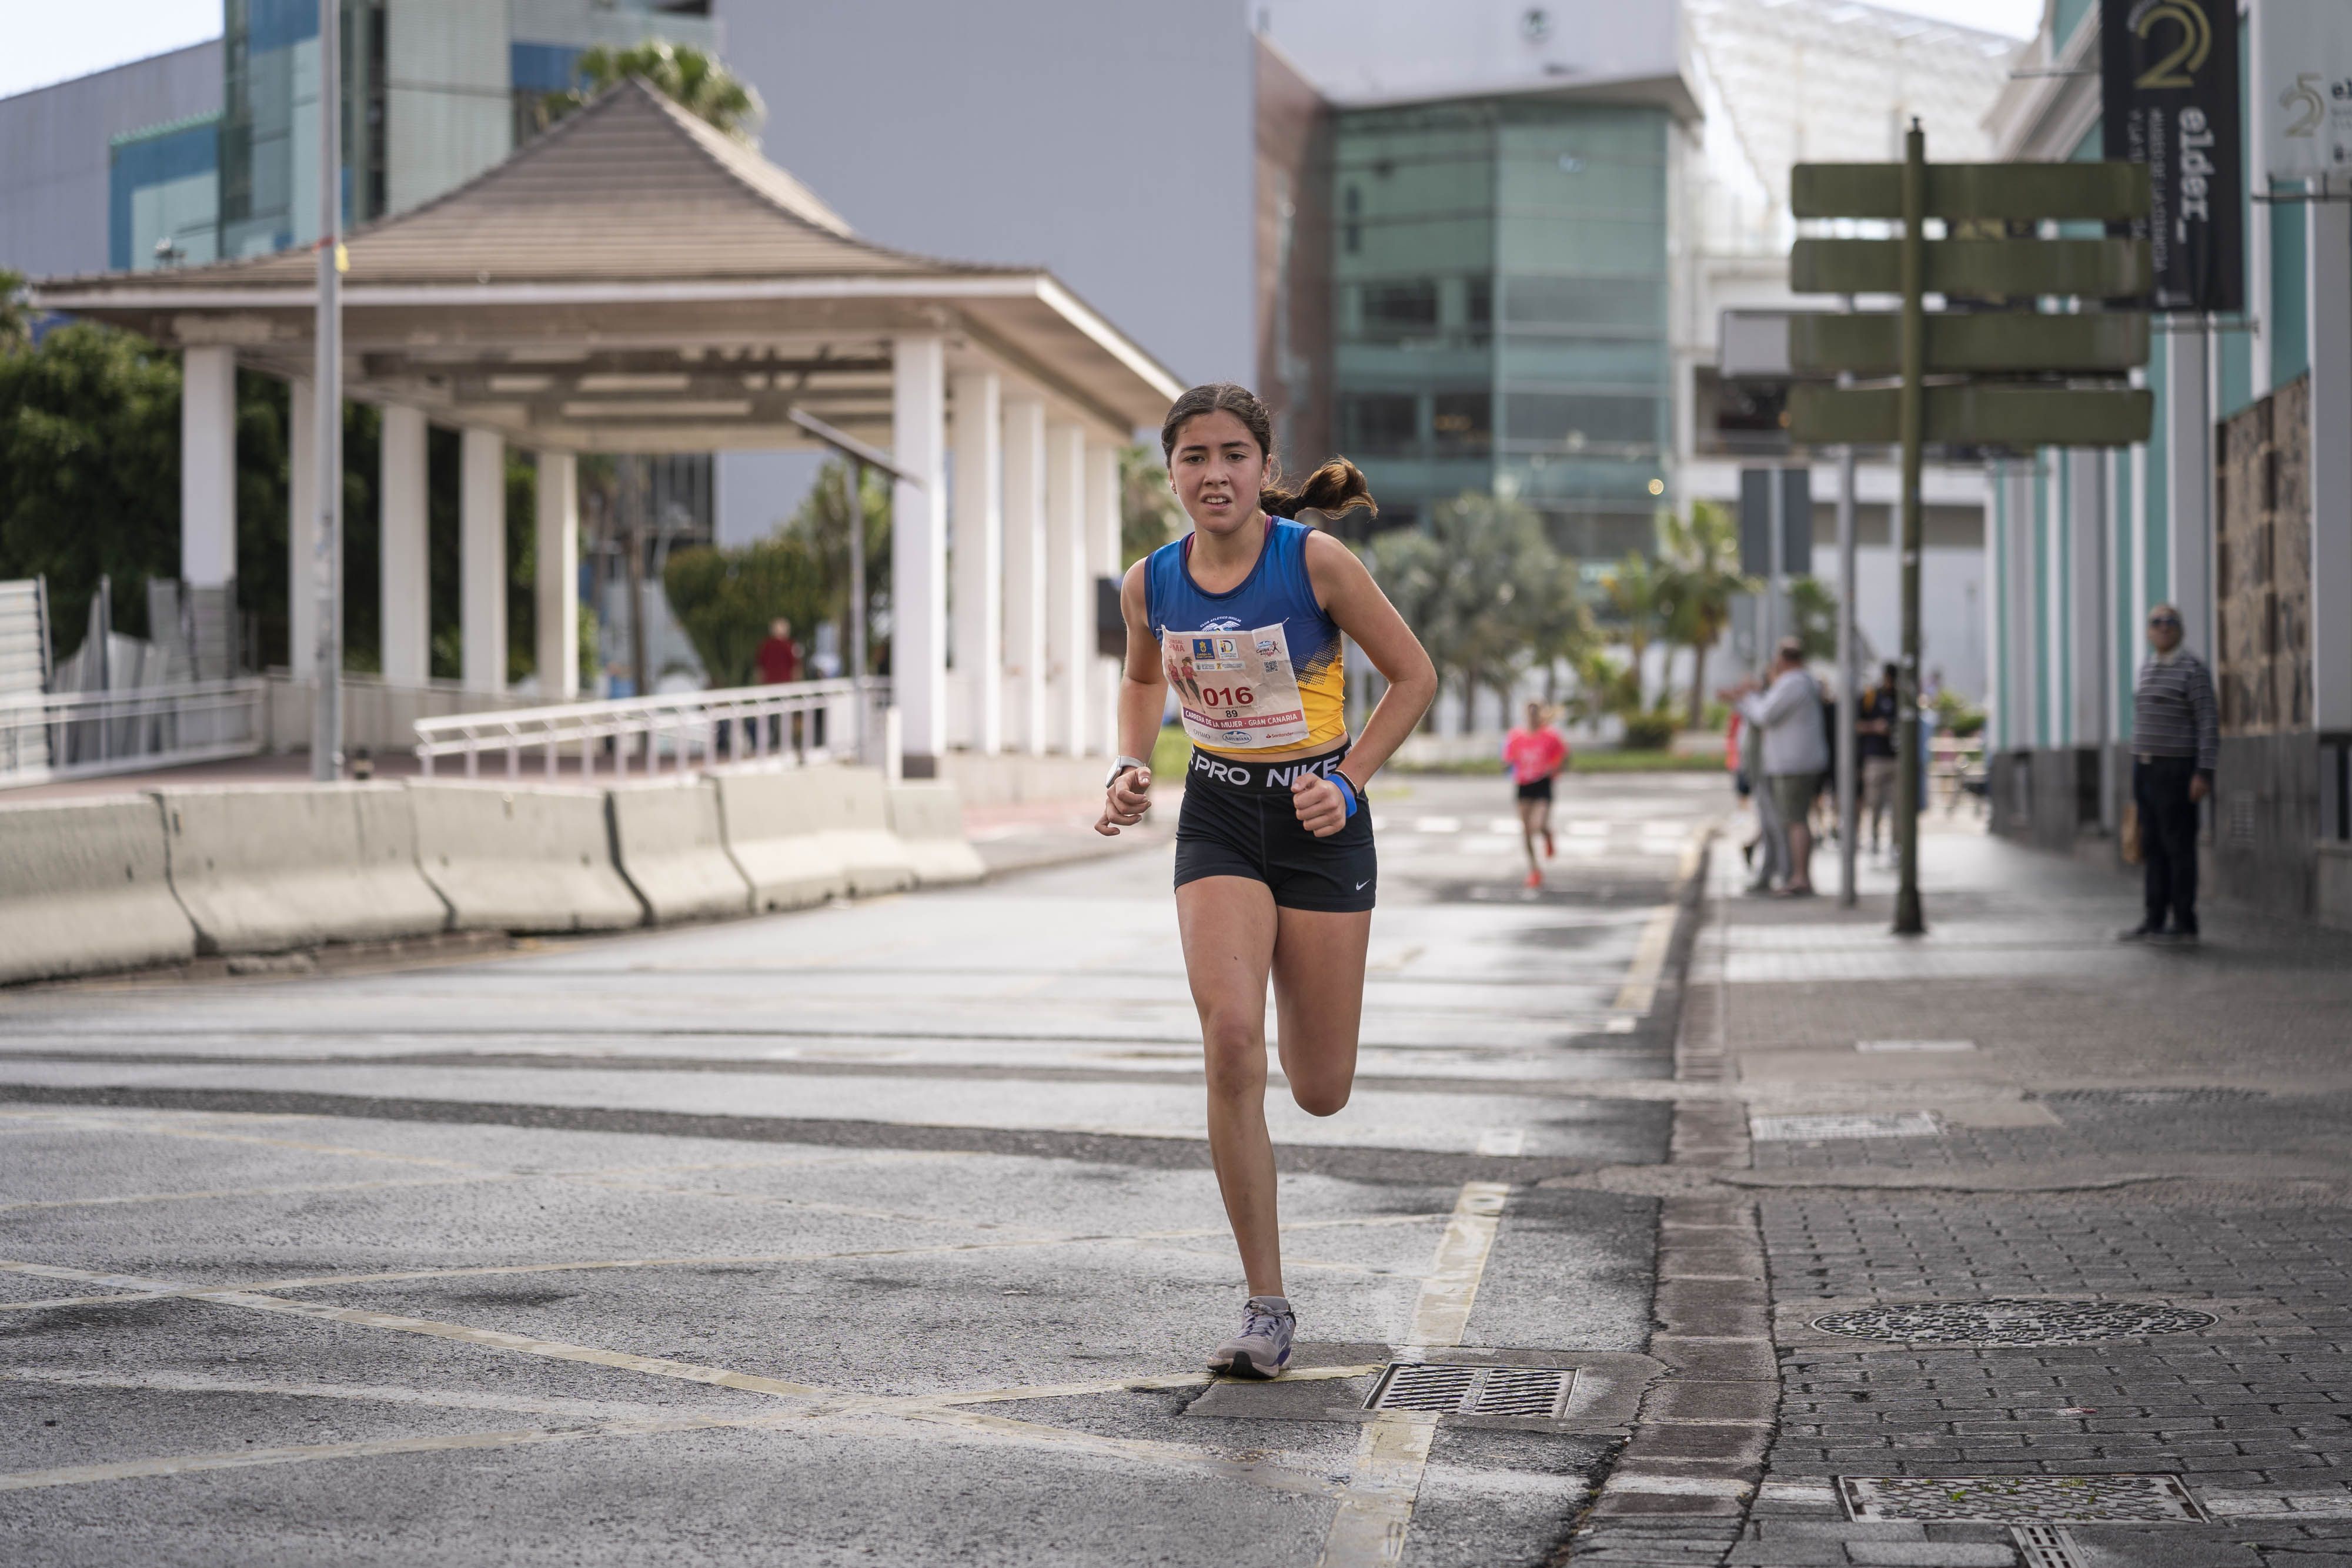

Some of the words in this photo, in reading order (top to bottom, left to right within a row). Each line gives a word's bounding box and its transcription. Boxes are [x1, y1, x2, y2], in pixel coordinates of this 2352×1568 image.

[1202, 687, 1254, 706] 016
[1185, 710, 1205, 723] CARRERA
[1268, 714, 1298, 724] CANARIA
[1225, 710, 1238, 718] 89
[1193, 728, 1210, 739] OYSHO
[1194, 754, 1250, 785] PRO
[1266, 755, 1339, 787] NIKE
